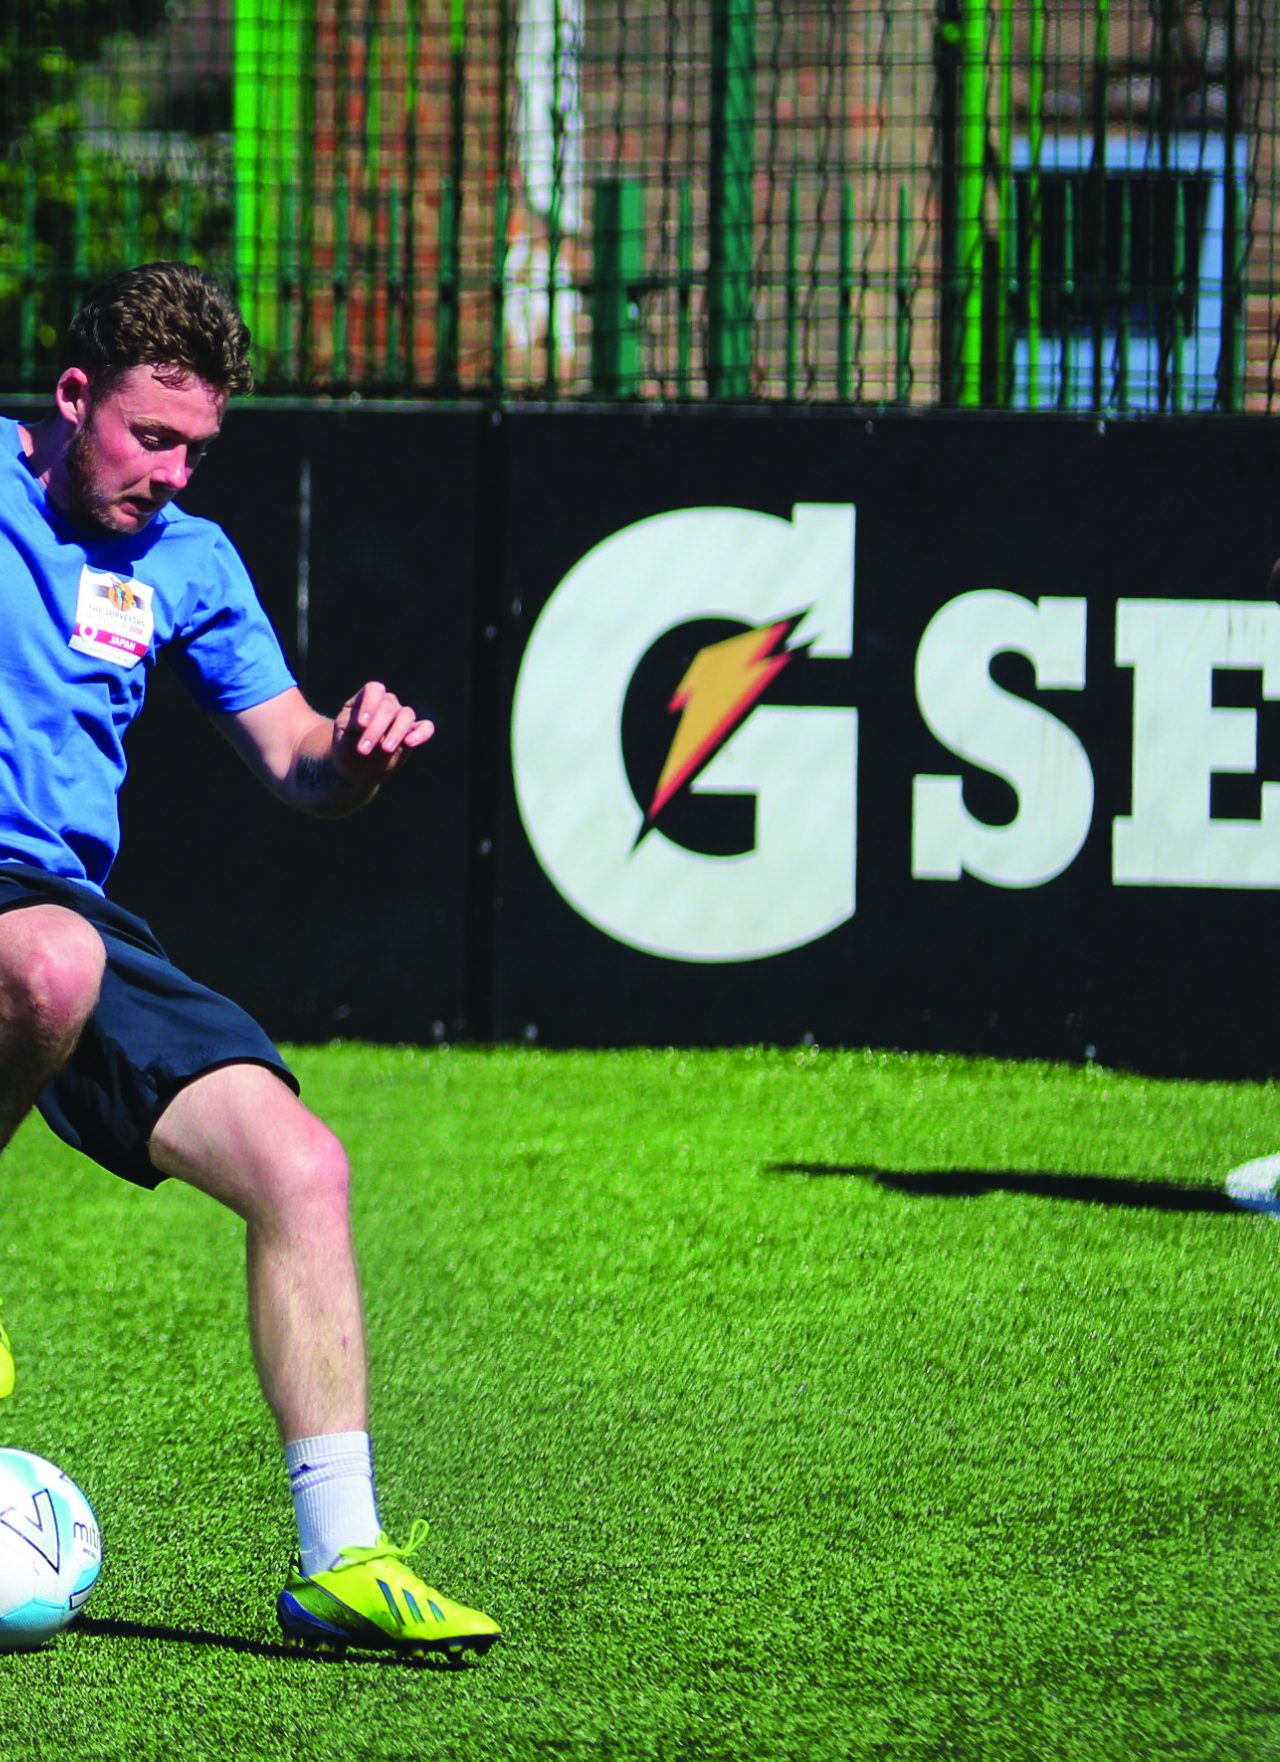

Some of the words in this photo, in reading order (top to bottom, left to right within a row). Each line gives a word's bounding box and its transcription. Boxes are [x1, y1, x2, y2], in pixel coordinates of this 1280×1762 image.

[105, 608, 145, 627] SURVEYORS
[108, 635, 136, 652] JAPAN
[511, 503, 858, 963] G
[912, 589, 1280, 890] SE
